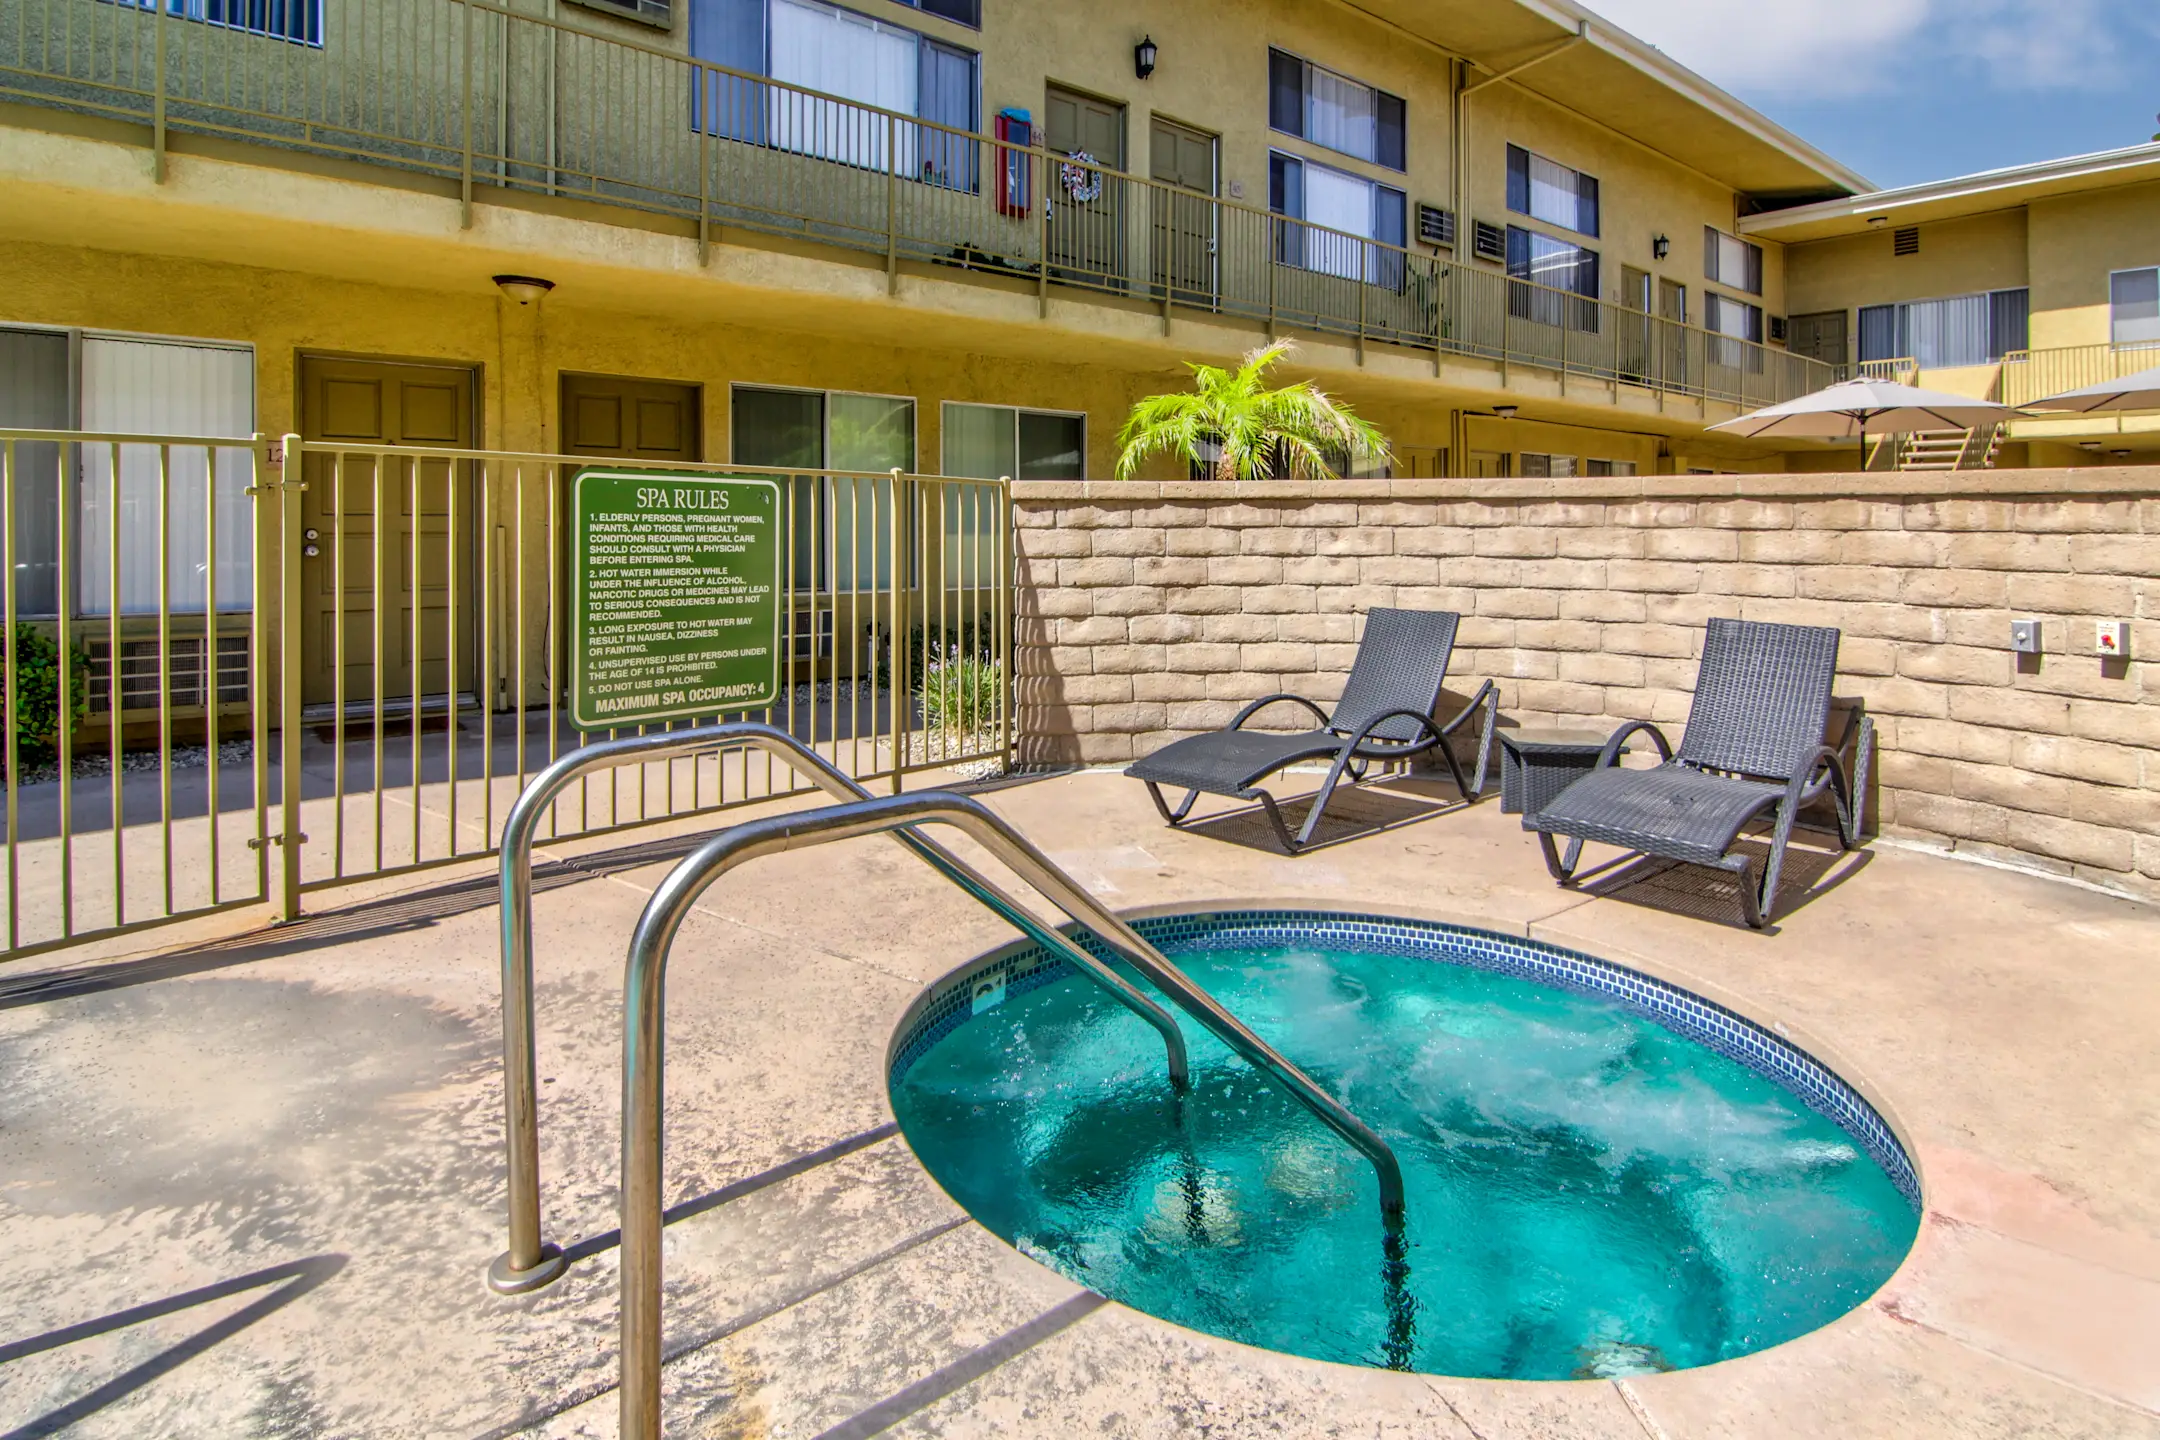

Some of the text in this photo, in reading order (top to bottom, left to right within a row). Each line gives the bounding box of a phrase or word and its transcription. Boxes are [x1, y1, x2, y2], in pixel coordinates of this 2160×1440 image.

[637, 488, 729, 509] SPA RULES
[600, 514, 639, 522] ELDERLY
[642, 514, 685, 523] PERSONS,
[687, 515, 731, 523] PREGNANT
[733, 516, 764, 524] WOMEN,
[590, 524, 630, 533] INFANTS,
[590, 535, 645, 543] CONDITIONS
[648, 535, 694, 543] REQUIRING
[630, 545, 670, 553] CONSULT
[672, 545, 693, 553] WITH
[590, 556, 627, 564] BEFORE
[630, 556, 673, 564] ENTERING
[590, 567, 727, 578] 2. HOT WATER IMMERSION WHILE
[589, 577, 746, 588] UNDER THE INFLUENCE OF ALCOHOL,
[590, 590, 636, 599] NARCOTIC
[639, 589, 669, 597] DRUGS
[671, 588, 682, 596] OR
[685, 587, 729, 595] MEDICINES
[749, 585, 769, 593] LEAD
[590, 602, 602, 610] TO
[604, 600, 644, 609] SERIOUS
[646, 597, 715, 608] CONSEQUENCES
[736, 596, 743, 604] IS
[589, 610, 662, 621] RECOMMENDED.
[589, 617, 752, 635] 3. LONG EXPOSURE TO HOT WATER MAY
[589, 630, 718, 646] RESULT IN NAUSEA, DIZZINESS
[589, 645, 648, 656] OR FAINTING.
[589, 648, 766, 670] 4. UNSUPERVISED USE BY PERSONS UNDER
[589, 662, 717, 681] THE AGE OF 14 IS PROHIBITED.
[589, 675, 703, 694] 5. DO NOT USE SPA ALONE.
[596, 682, 764, 713] MAXIMUM SPA OCCUPANCY: 4
